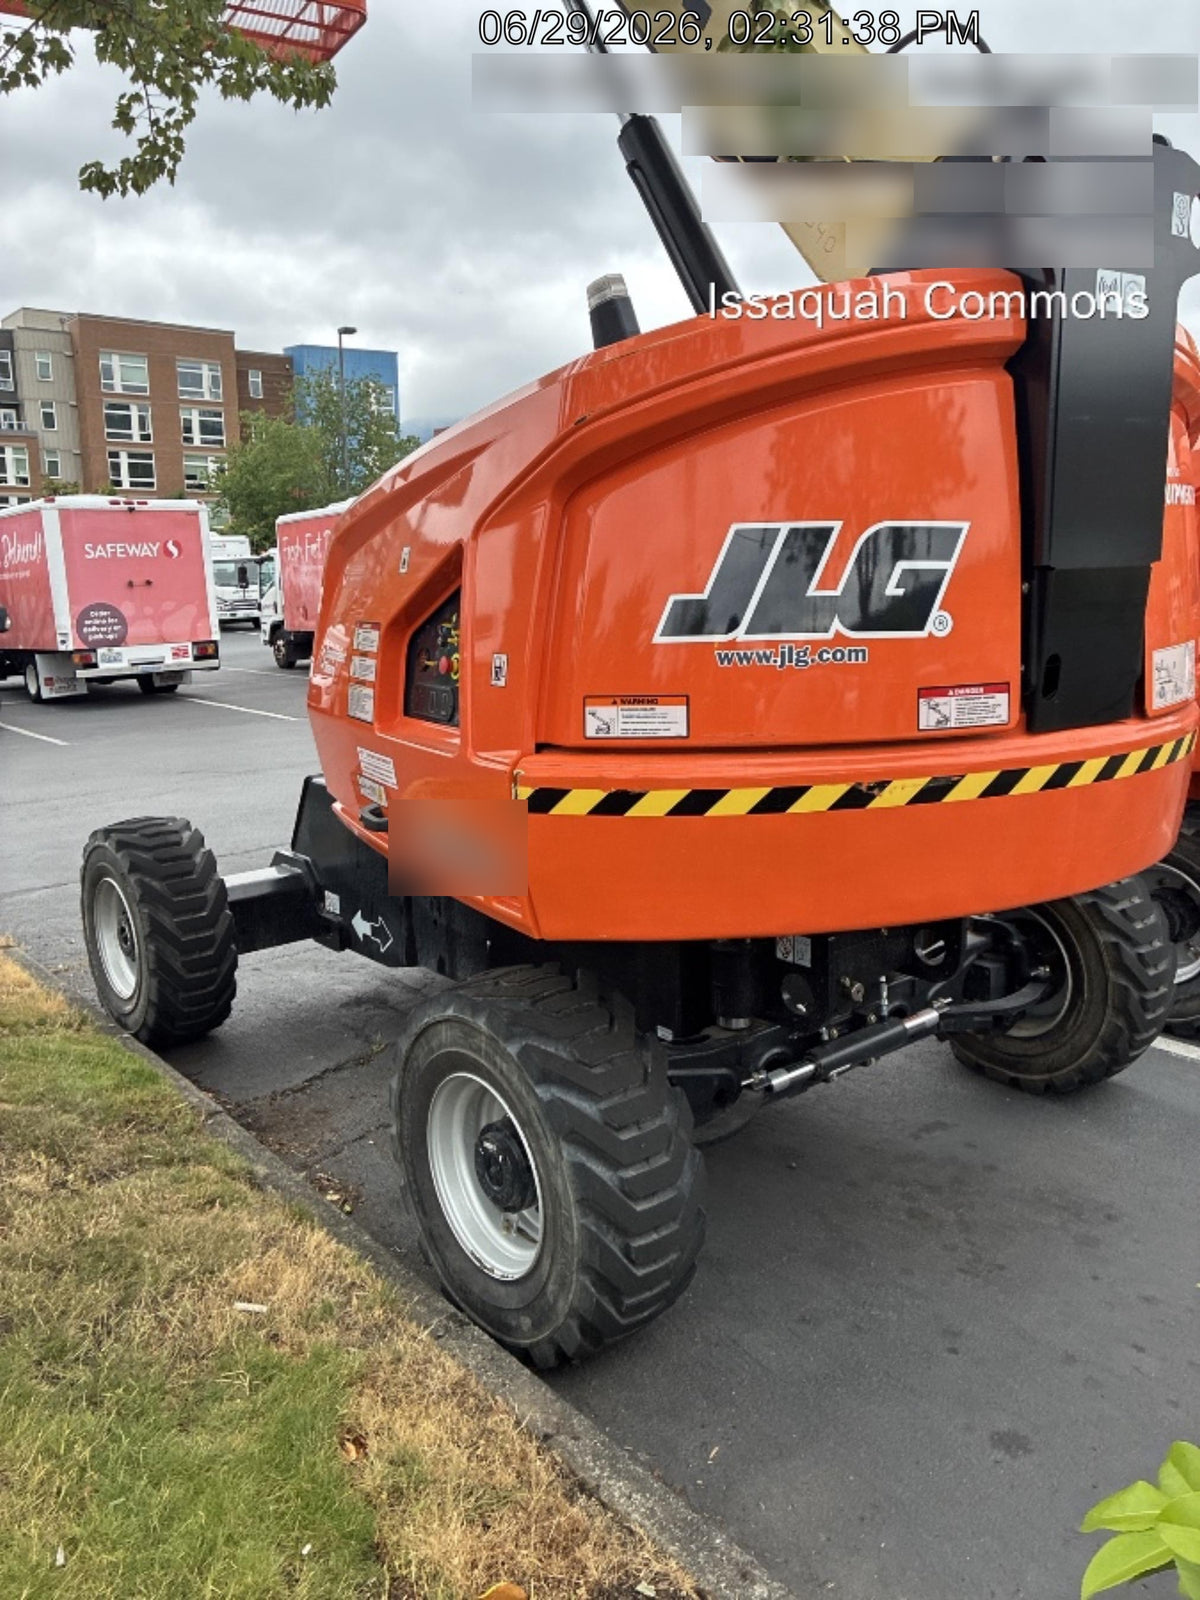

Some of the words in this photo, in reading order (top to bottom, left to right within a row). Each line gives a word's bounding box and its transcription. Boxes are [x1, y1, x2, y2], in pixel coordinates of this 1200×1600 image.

[84, 542, 161, 559] SAFEWAY
[652, 520, 971, 643] JLG
[715, 645, 868, 668] www.jlg.com
